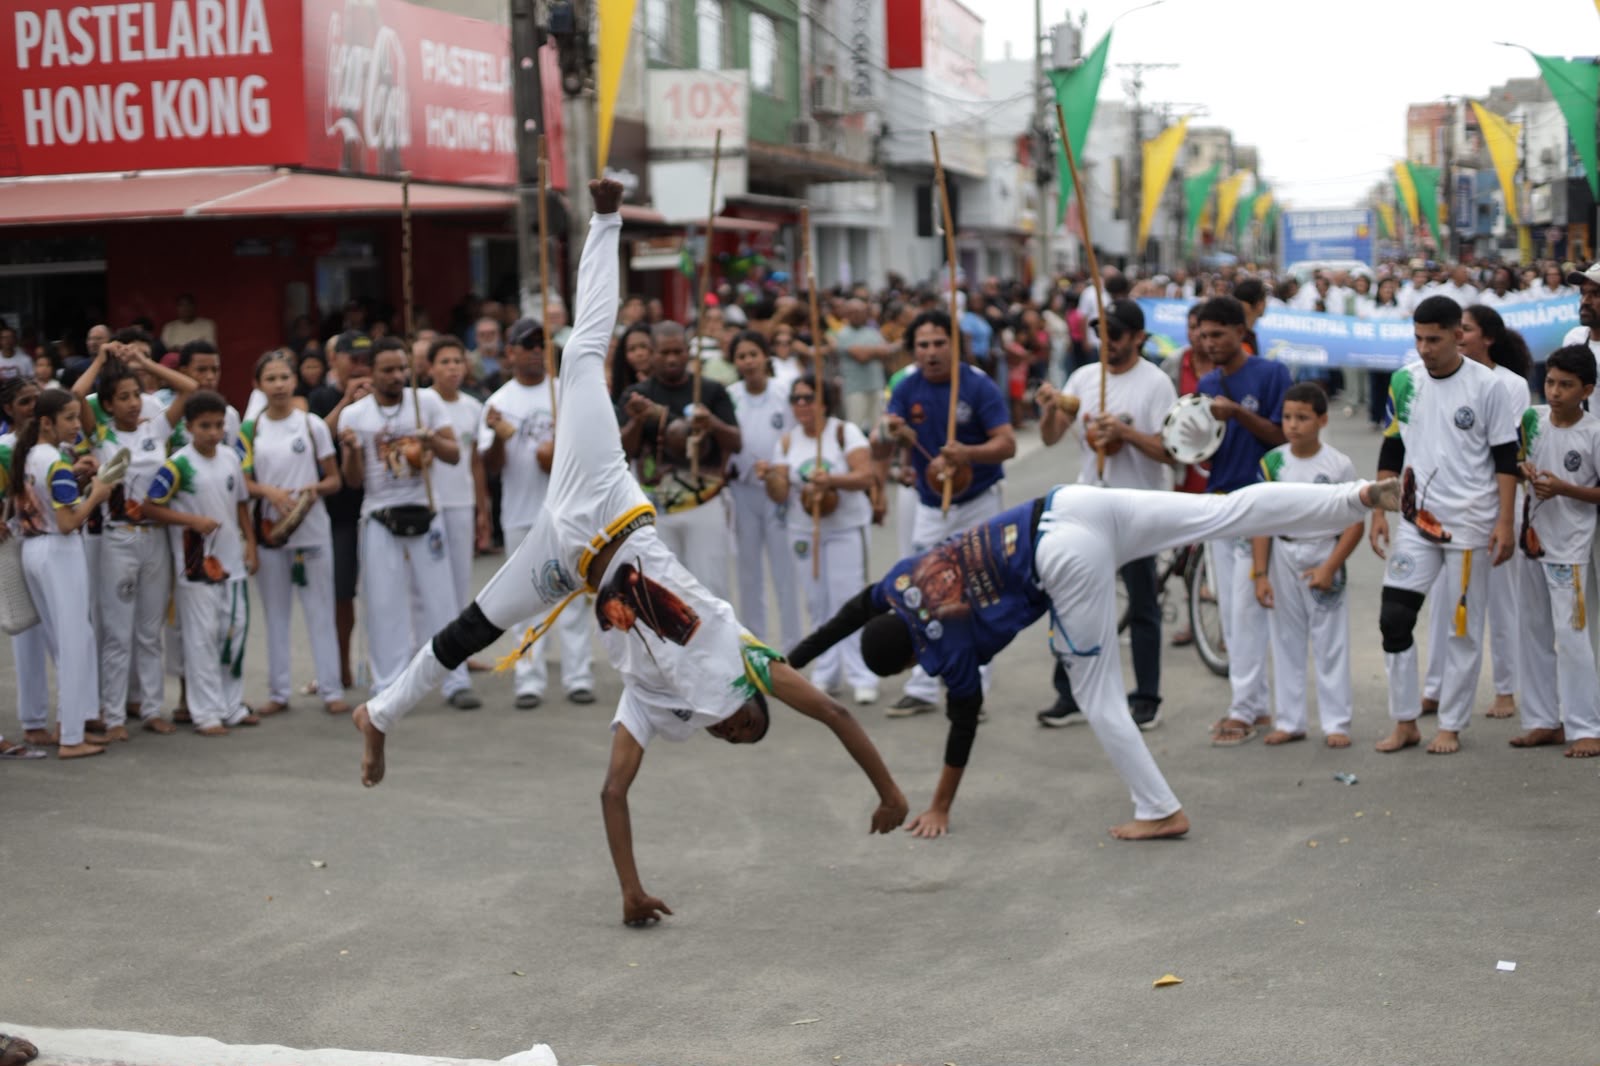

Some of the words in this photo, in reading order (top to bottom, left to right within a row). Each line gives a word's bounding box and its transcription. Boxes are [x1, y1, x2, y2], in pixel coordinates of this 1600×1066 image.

[14, 0, 273, 69] PASTELARIA
[22, 81, 144, 146] HONG
[151, 74, 272, 139] KONG
[425, 104, 490, 153] HONG
[663, 82, 741, 120] 10X
